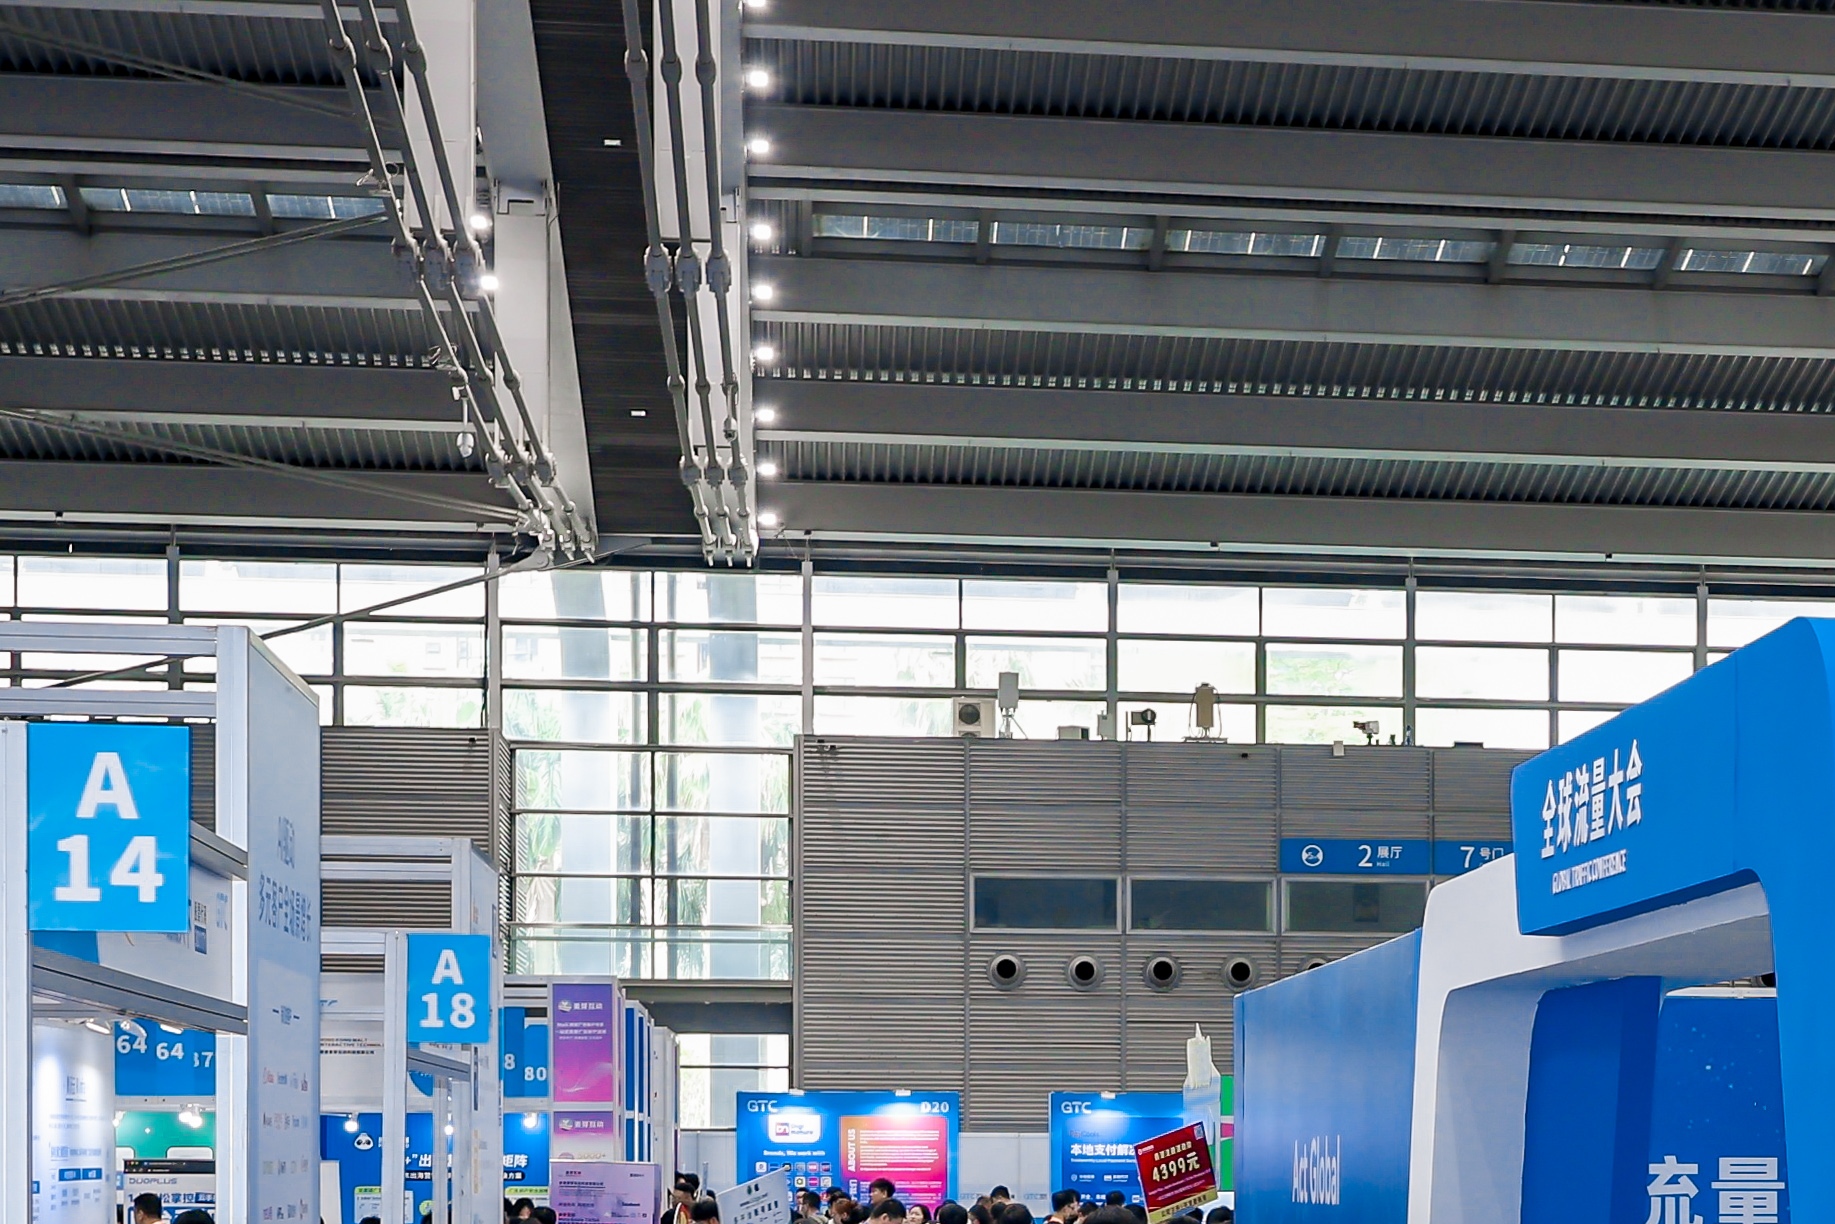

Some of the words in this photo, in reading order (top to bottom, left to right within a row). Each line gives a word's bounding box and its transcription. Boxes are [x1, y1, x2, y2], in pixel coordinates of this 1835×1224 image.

[76, 751, 138, 818] A
[1541, 738, 1643, 859] 全球流量大会
[53, 835, 164, 902] 14
[1358, 845, 1373, 867] 2
[1376, 846, 1403, 859] 展厅
[1460, 846, 1475, 868] 7
[431, 949, 463, 985] A
[419, 992, 476, 1029] 18
[116, 1034, 148, 1054] 64
[156, 1042, 184, 1060] 64
[524, 1066, 547, 1081] 80
[747, 1100, 778, 1113] GTC
[920, 1101, 949, 1113] D20
[1061, 1101, 1092, 1114] GTC
[1152, 1151, 1200, 1182] 4399元
[1310, 1134, 1340, 1205] Global
